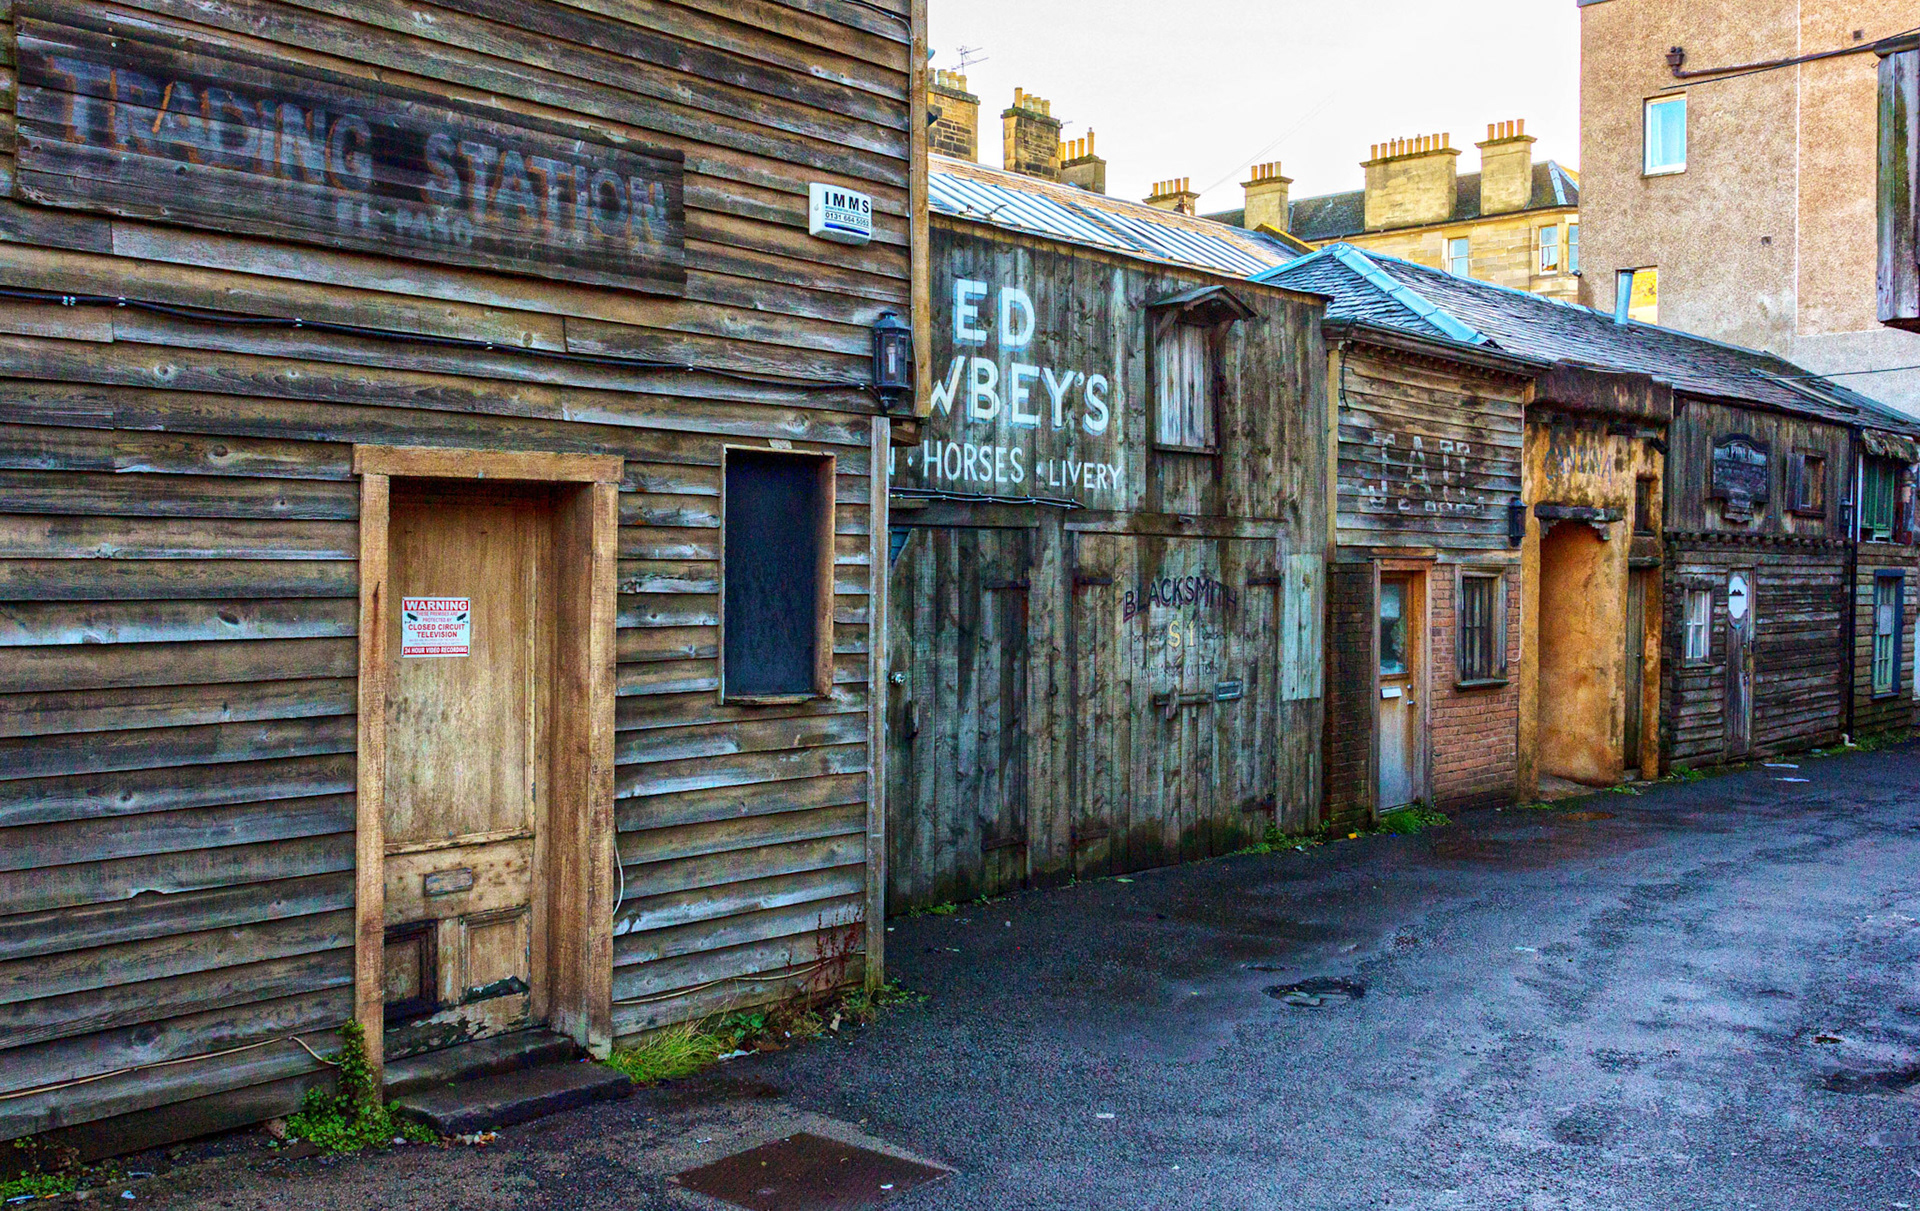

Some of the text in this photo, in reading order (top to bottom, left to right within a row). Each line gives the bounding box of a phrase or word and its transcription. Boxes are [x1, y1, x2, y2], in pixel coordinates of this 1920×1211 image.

[46, 54, 667, 246] TRADING STATION
[825, 191, 869, 214] IMMS
[825, 211, 842, 221] 0131
[952, 279, 1036, 351] ED
[923, 440, 1025, 483] HORSES
[1050, 459, 1123, 490] LIVERY
[406, 601, 467, 610] WARNING
[1122, 575, 1238, 624] BLACKSMITH
